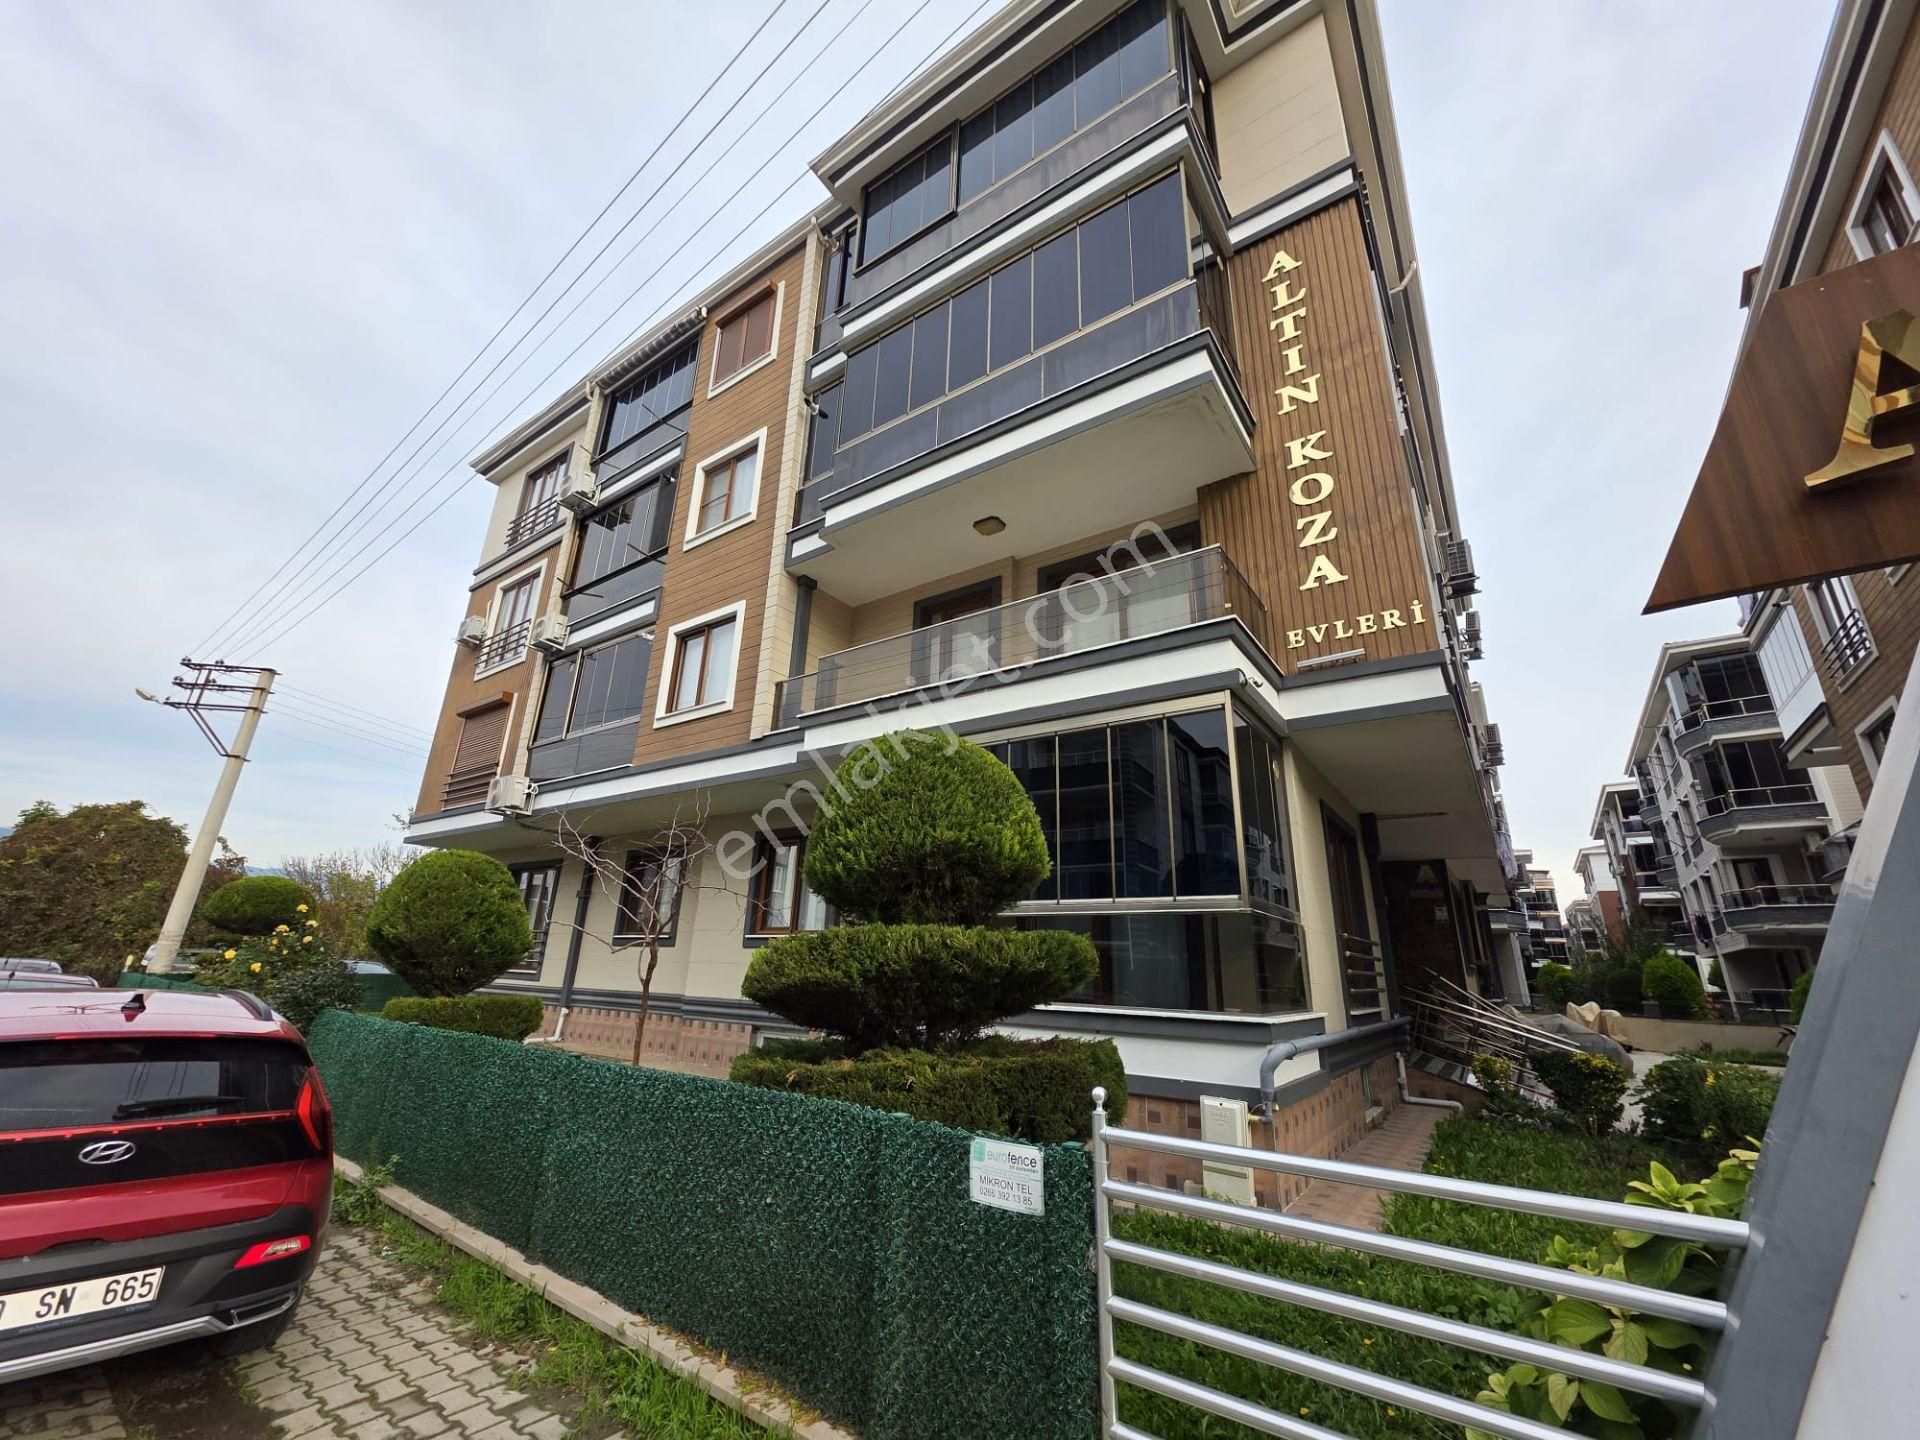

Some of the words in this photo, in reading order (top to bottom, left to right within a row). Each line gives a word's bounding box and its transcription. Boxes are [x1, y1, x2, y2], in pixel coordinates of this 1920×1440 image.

[1261, 249, 1321, 416] ALTIN
[1283, 429, 1349, 592] KOZA
[1285, 599, 1427, 650] EVLERİ
[1016, 1183, 1033, 1195] TEL
[35, 1286, 77, 1319] SN
[102, 1272, 157, 1306] 665
